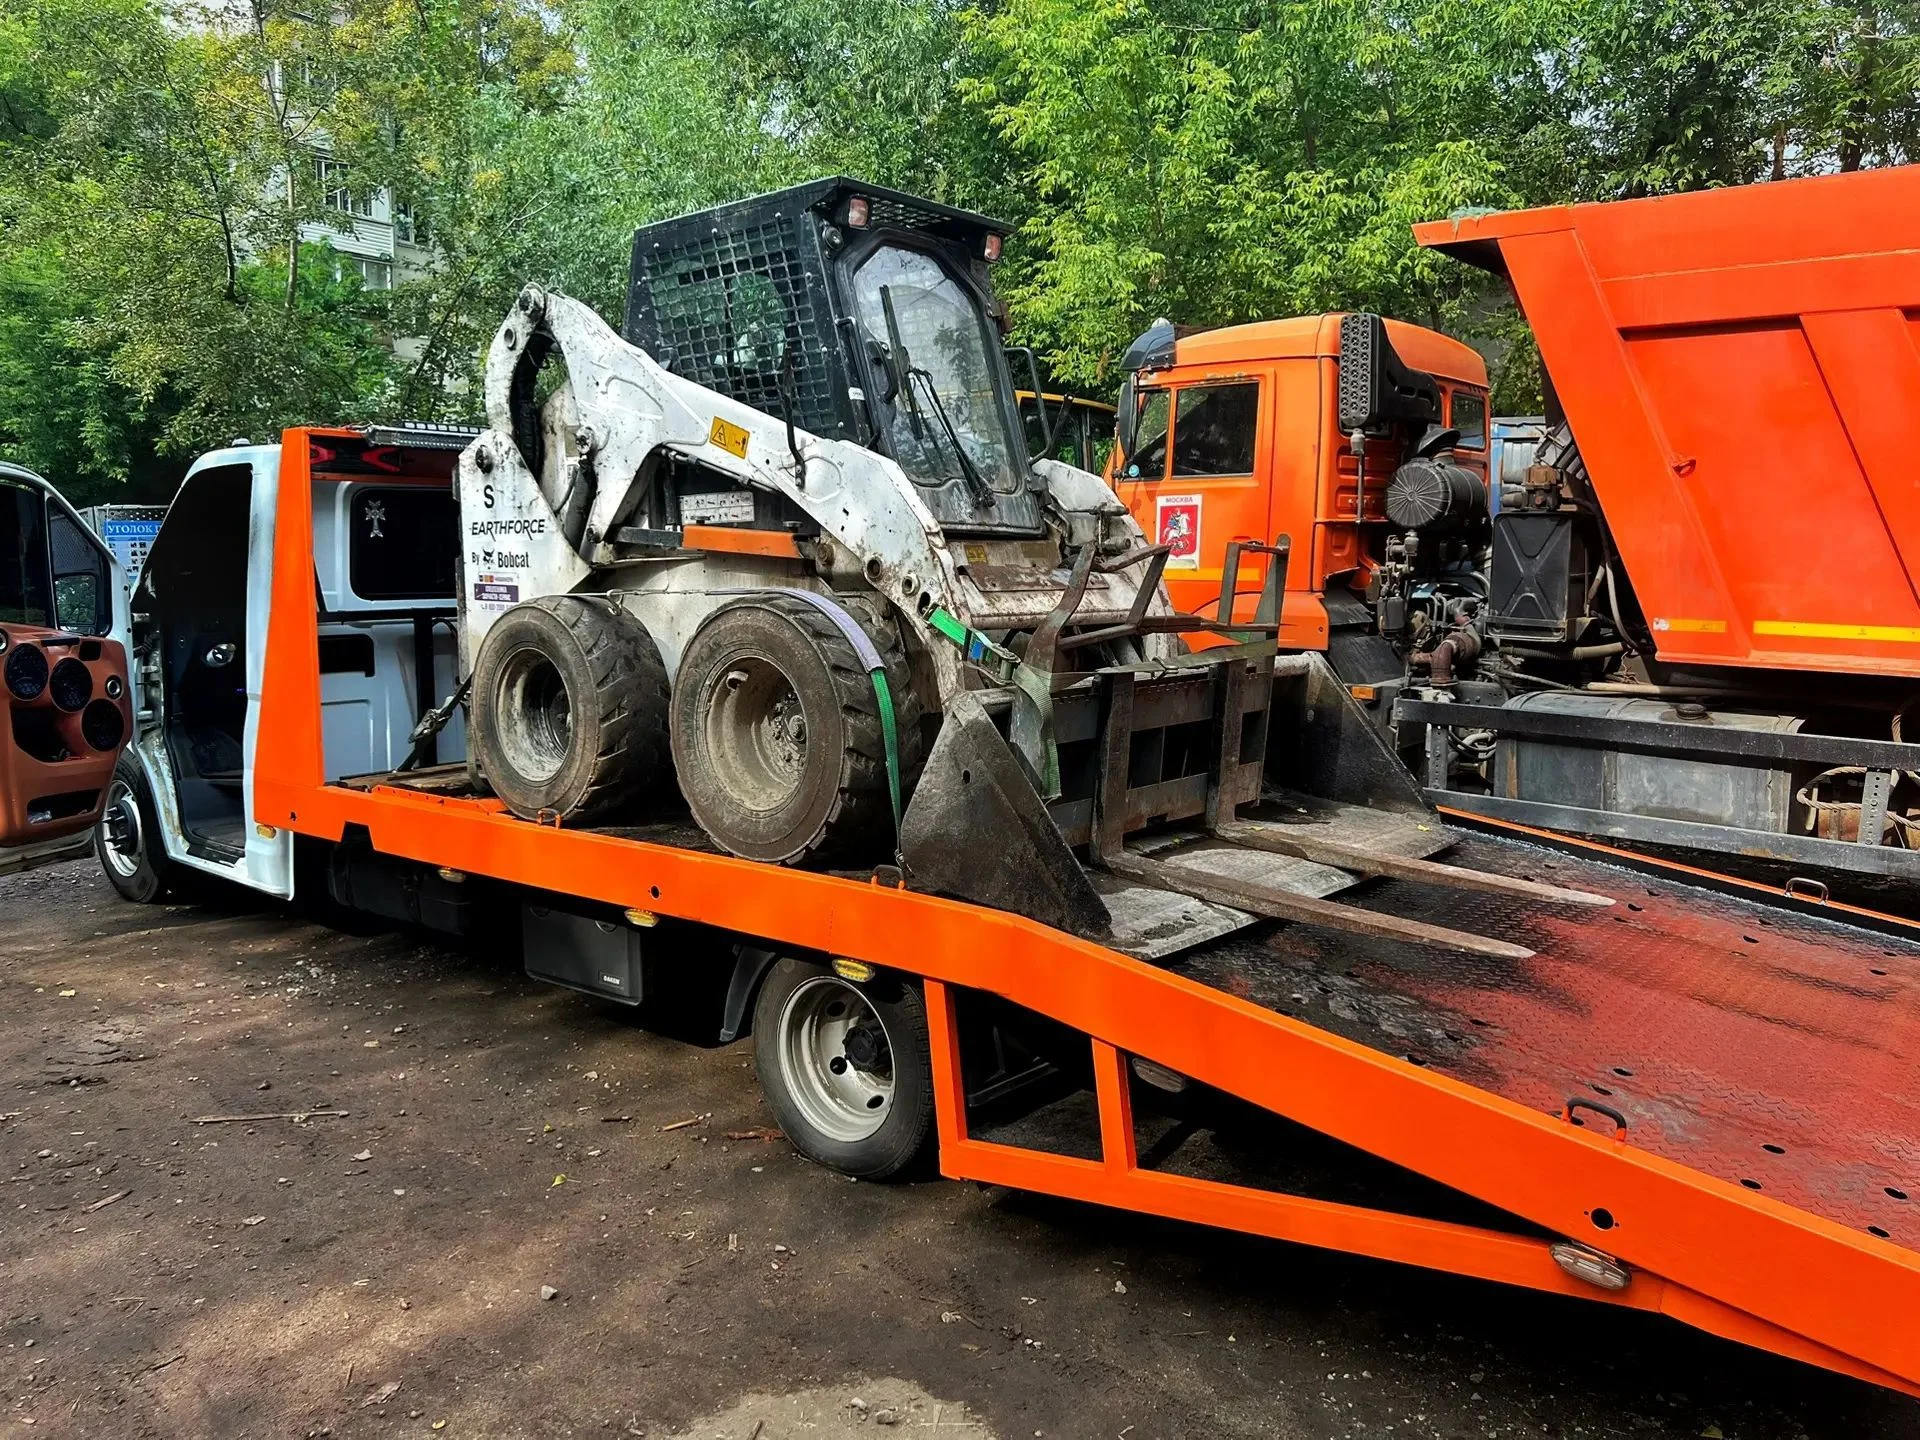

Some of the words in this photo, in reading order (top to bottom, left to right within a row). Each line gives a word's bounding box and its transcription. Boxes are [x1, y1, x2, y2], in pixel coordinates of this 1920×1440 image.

[483, 484, 495, 509] S
[1165, 496, 1193, 504] МОСКВА
[108, 525, 153, 534] УГОЛОК
[471, 519, 546, 542] EARTHFORCE
[472, 552, 480, 565] By
[497, 551, 530, 568] Bobcat
